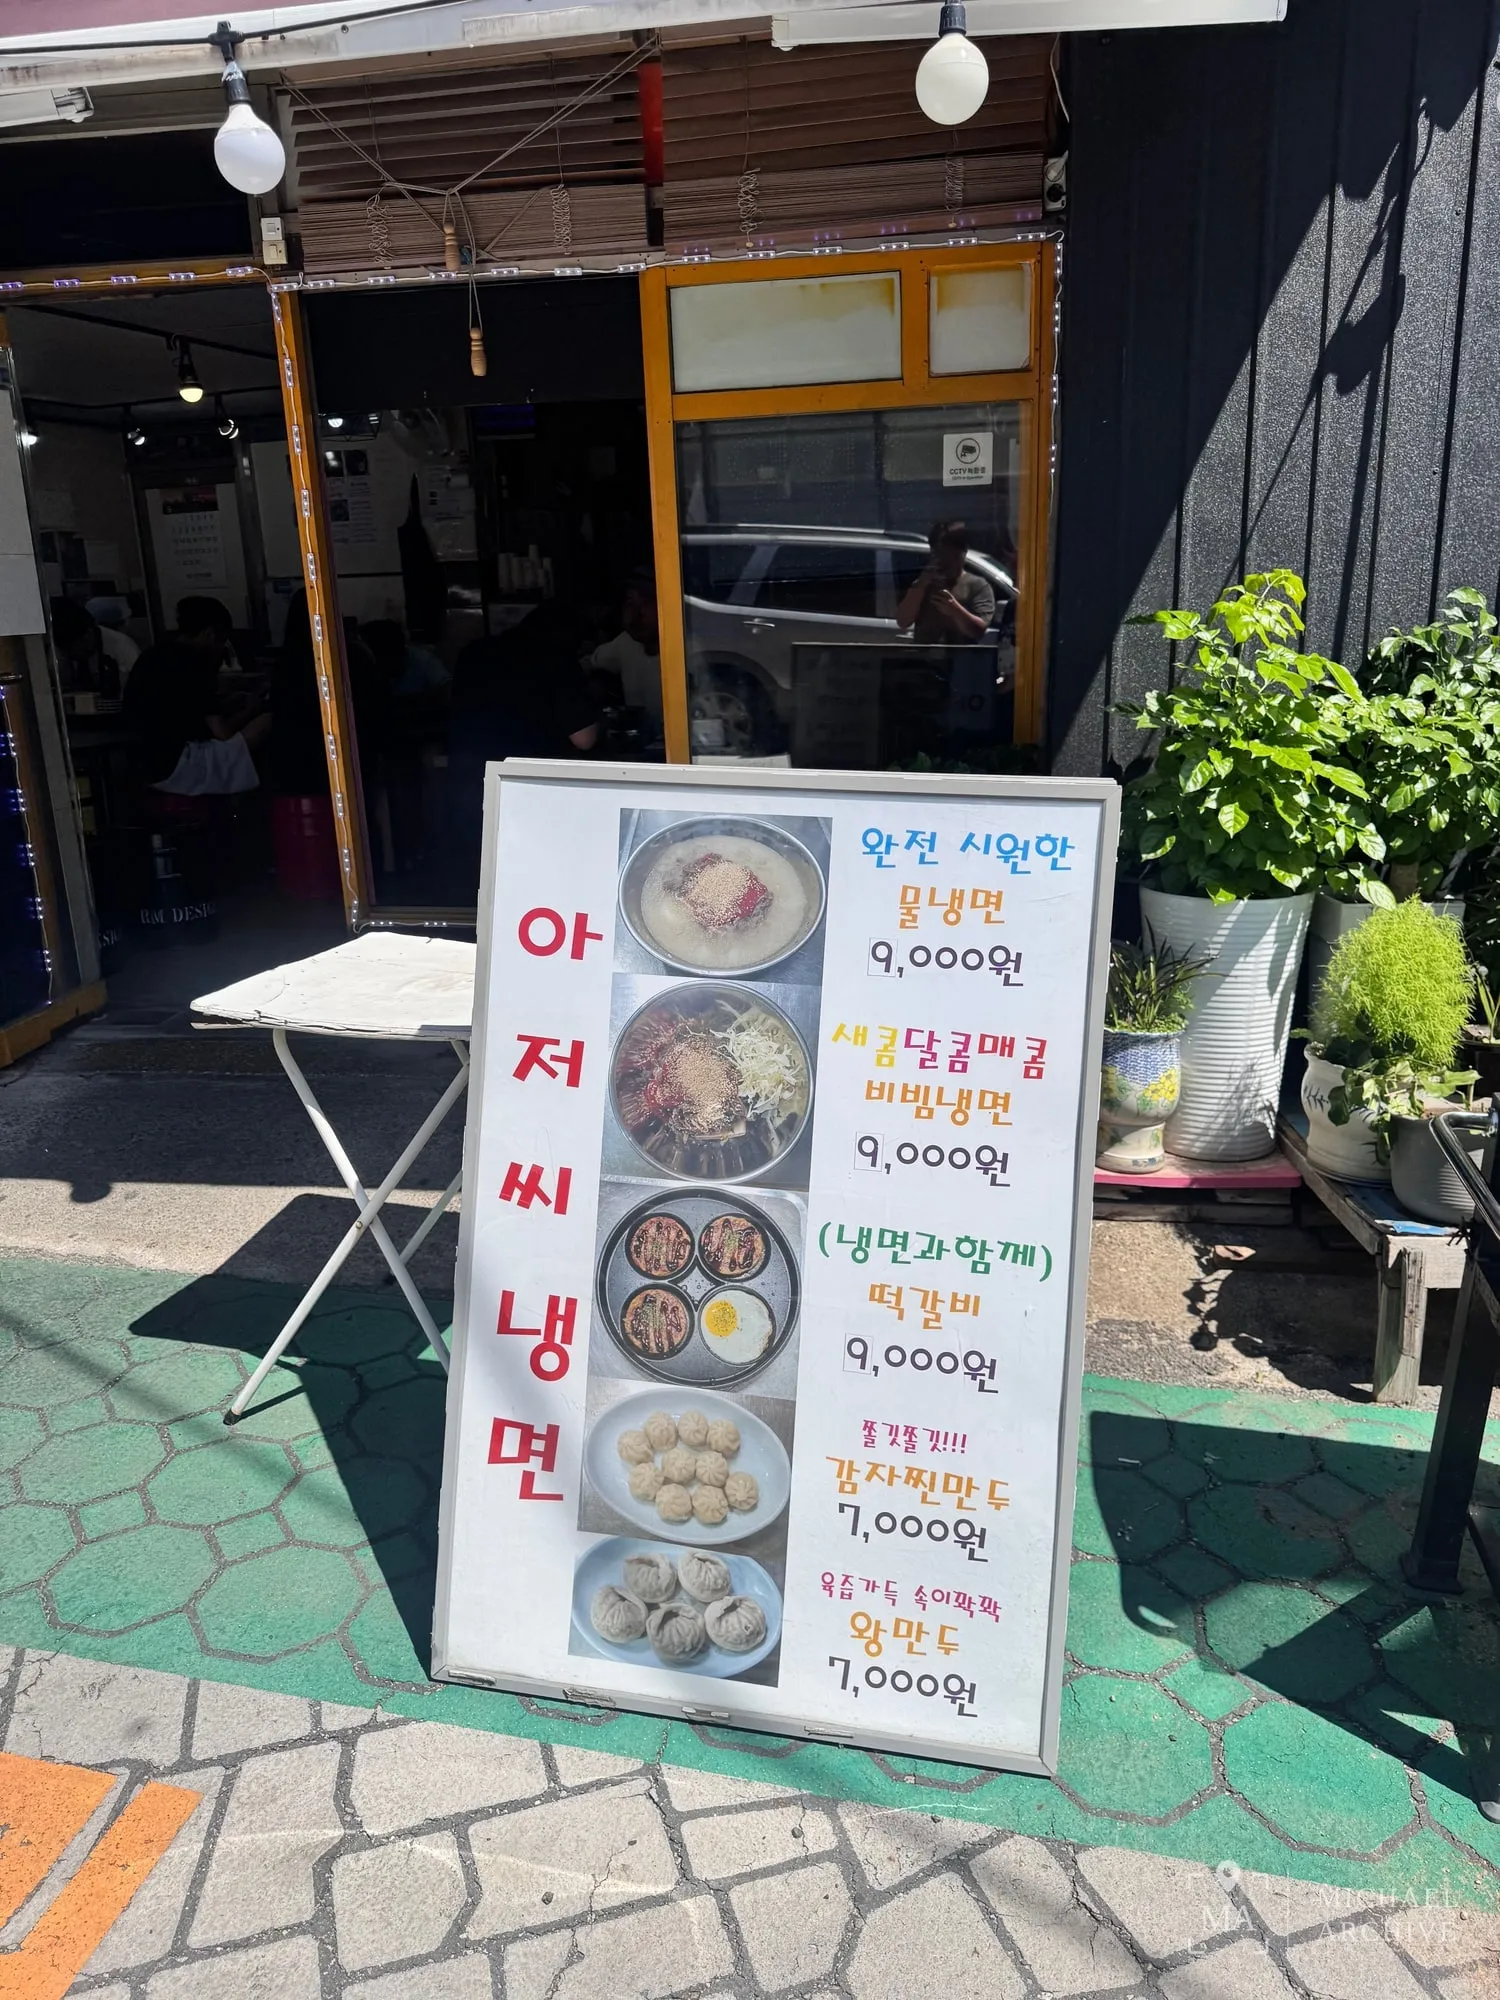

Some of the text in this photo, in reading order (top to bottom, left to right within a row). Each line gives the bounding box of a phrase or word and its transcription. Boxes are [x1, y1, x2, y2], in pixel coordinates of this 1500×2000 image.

[861, 827, 1075, 875] 완전 시원한
[899, 885, 1003, 929] 물냉면
[871, 942, 1024, 987] 9,000원
[832, 1023, 1047, 1080] 새콤달콤매콤
[865, 1080, 1013, 1126] 비빔냉면
[857, 1135, 1011, 1187] 9,000원
[488, 907, 602, 1500] 아저씨냉면
[819, 1223, 1052, 1281] (냉면과함께)
[868, 1283, 981, 1330] 떡갈비
[846, 1337, 999, 1394] 9,000원
[862, 1420, 967, 1453] 쫄깃쫄깃!!!
[825, 1455, 1011, 1512] 감자찐만두
[838, 1502, 989, 1563] 7,000원
[820, 1571, 1003, 1624] 육즙가득 속이꽉꽉
[849, 1611, 960, 1658] 왕만두
[829, 1656, 978, 1718] 7,000원
